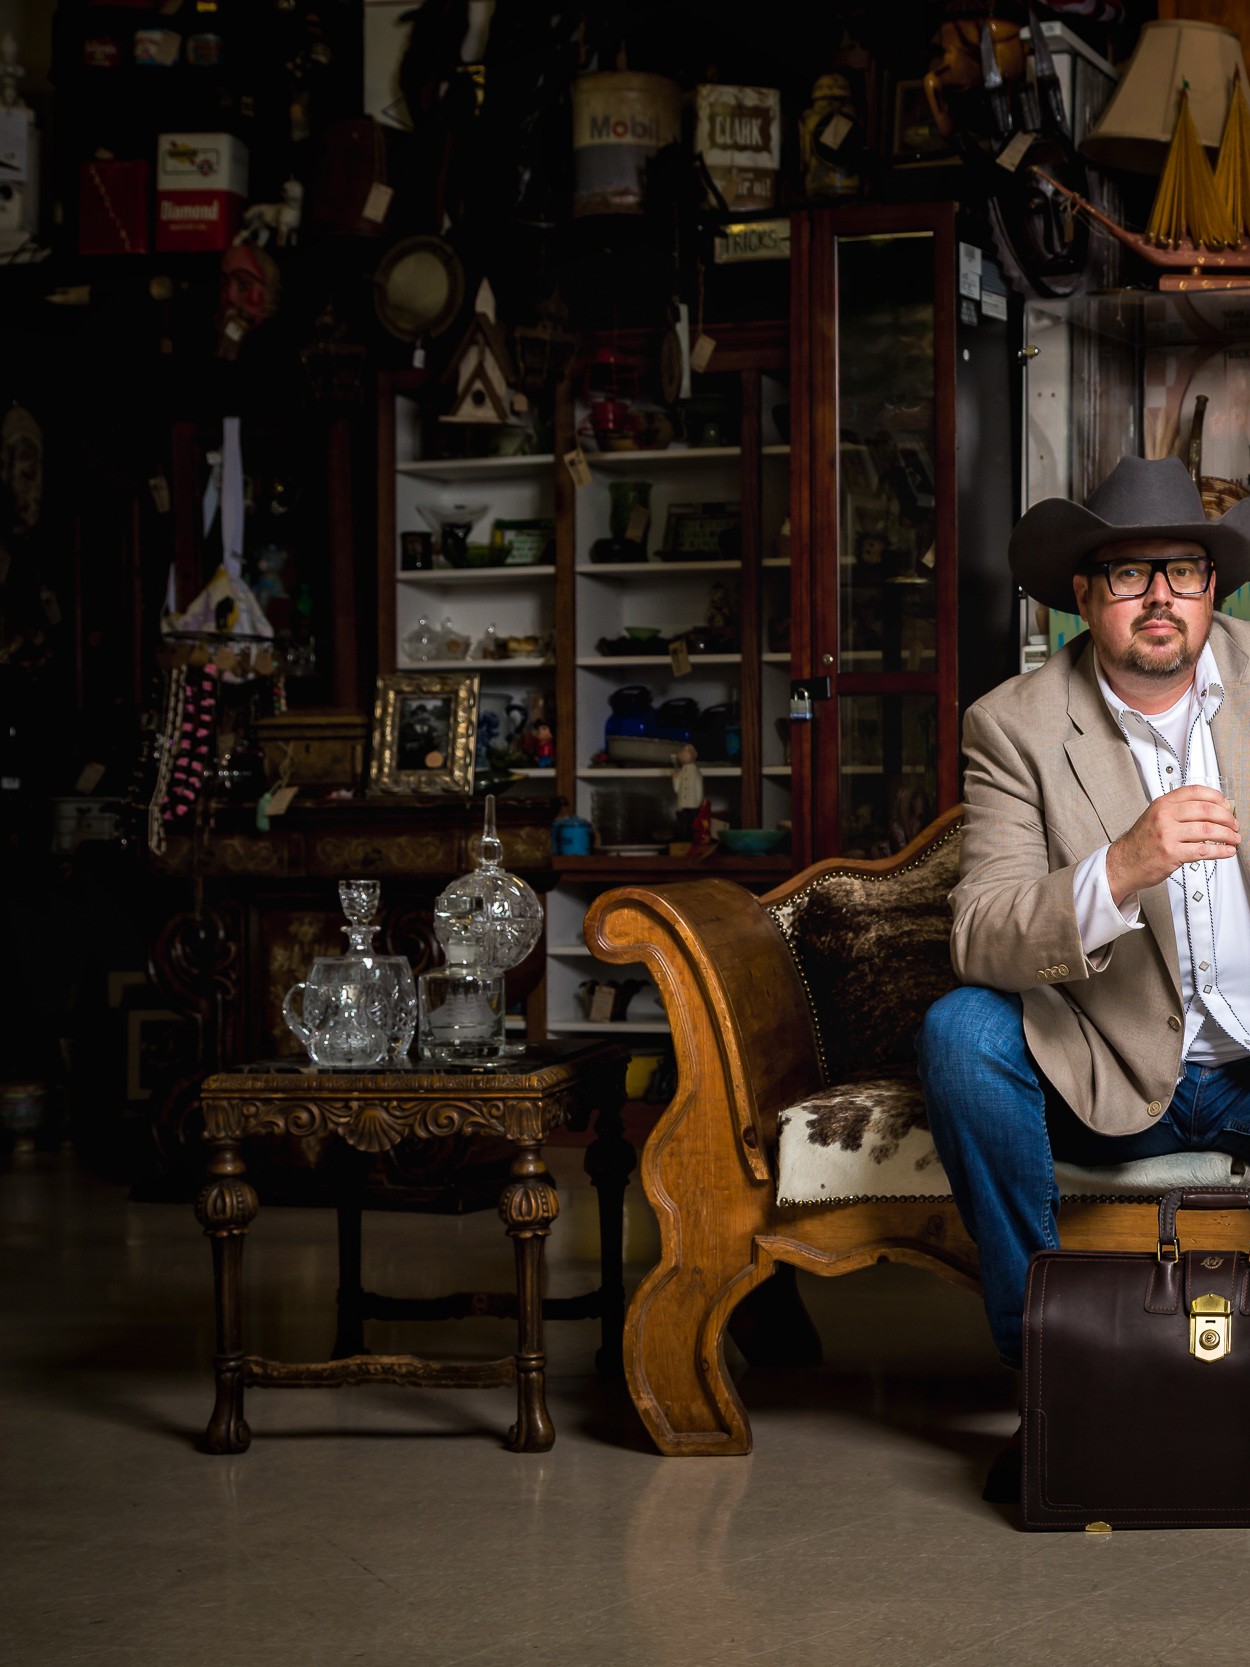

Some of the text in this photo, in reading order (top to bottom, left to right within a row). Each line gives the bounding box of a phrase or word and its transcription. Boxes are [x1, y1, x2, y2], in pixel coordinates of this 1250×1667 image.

[591, 115, 660, 141] Mobil
[714, 114, 764, 148] CLARK
[160, 198, 221, 222] Diamond
